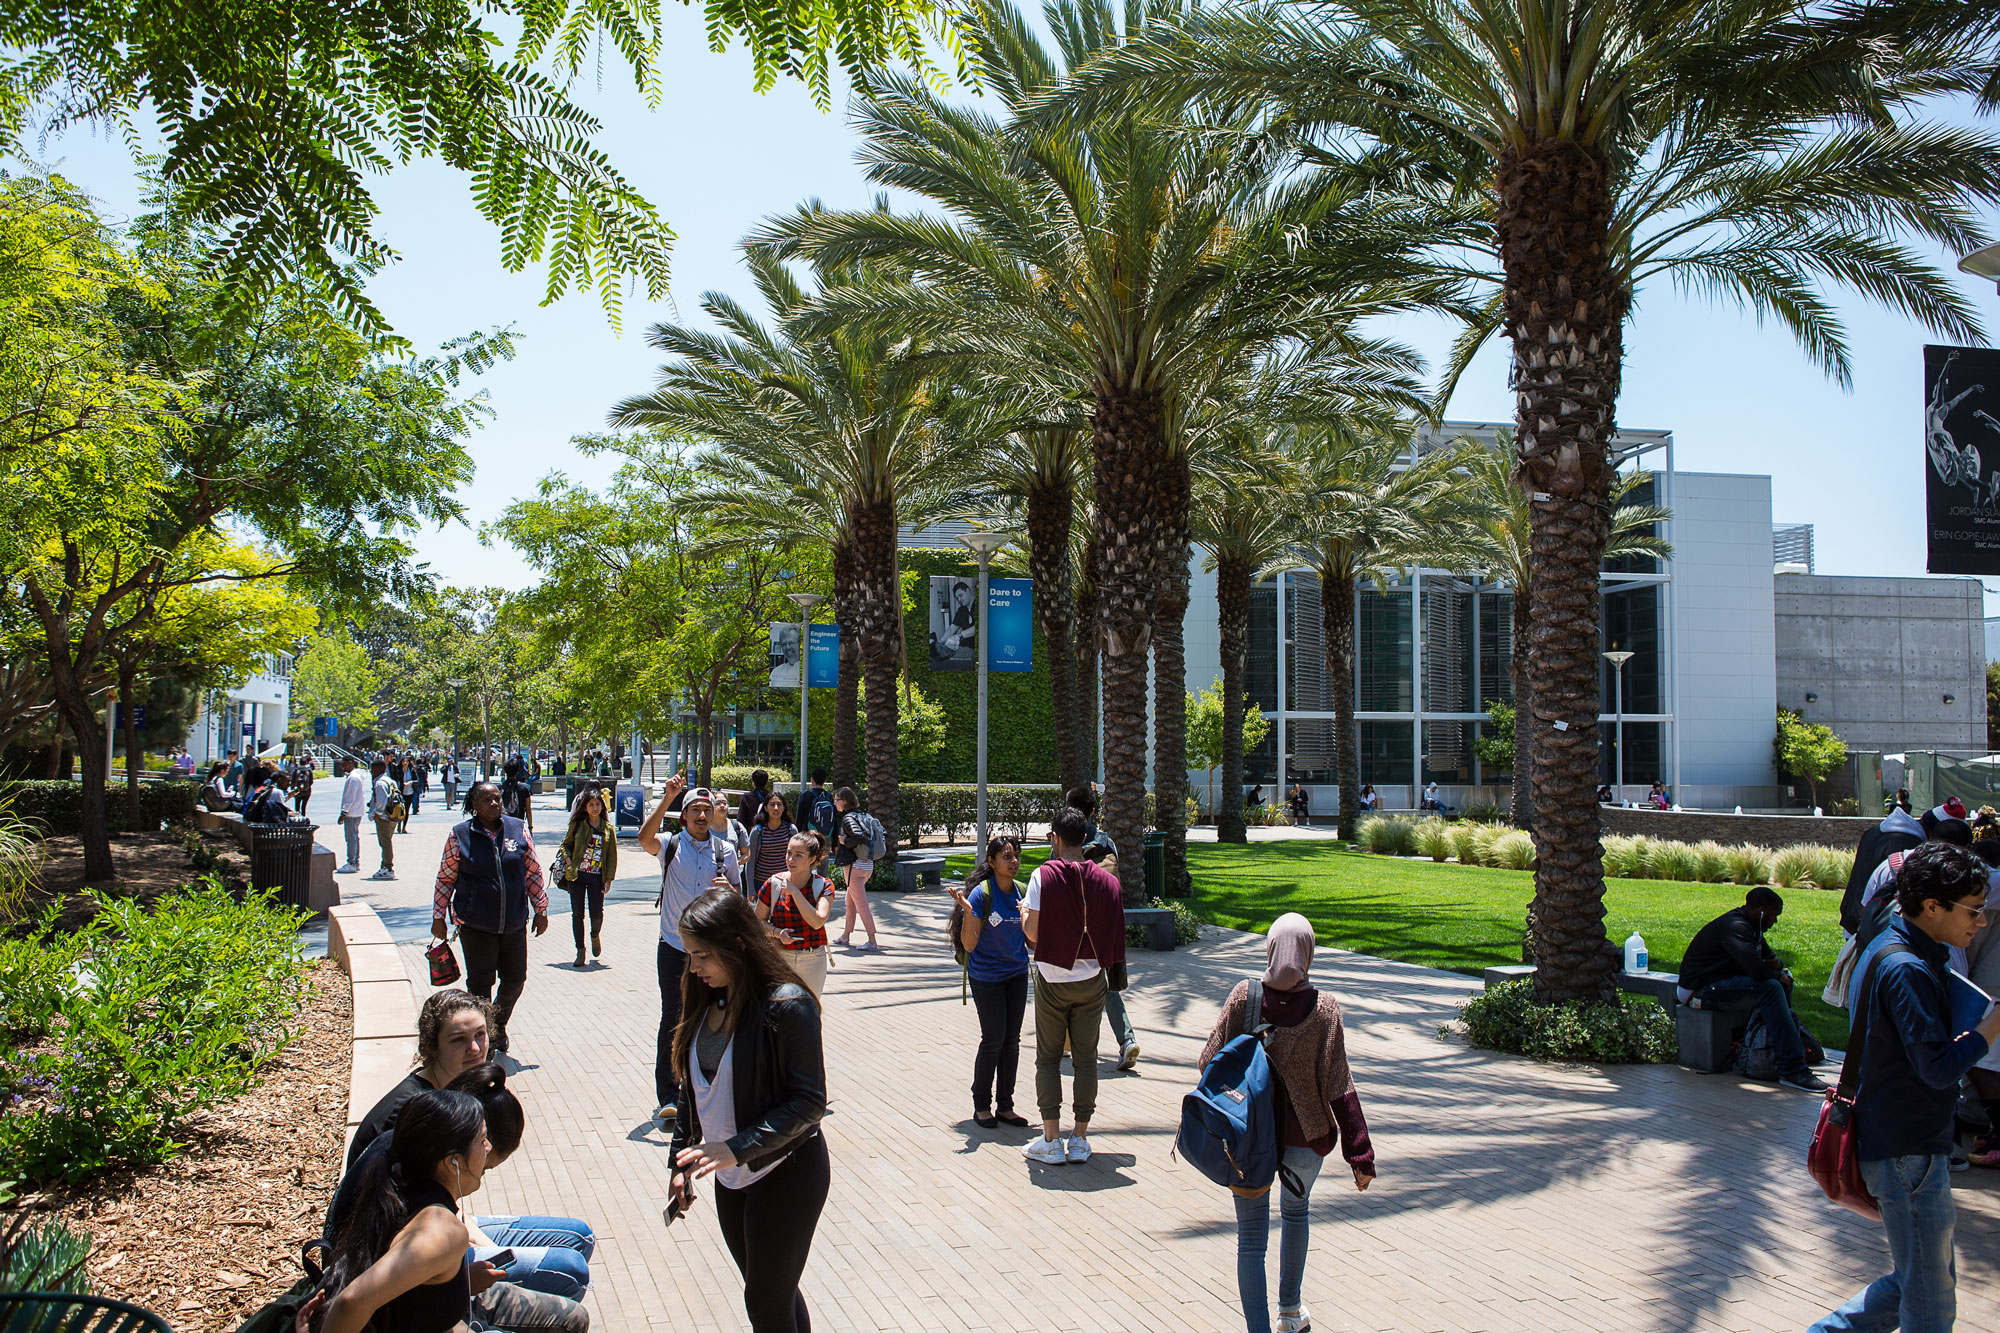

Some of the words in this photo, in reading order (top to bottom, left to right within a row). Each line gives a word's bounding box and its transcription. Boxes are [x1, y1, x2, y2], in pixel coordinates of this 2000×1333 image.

[1948, 506, 1983, 516] JORDAN
[1934, 530, 1953, 539] ERIN
[989, 588, 1010, 596] Dare
[1012, 589, 1022, 597] to
[989, 598, 1010, 606] Care
